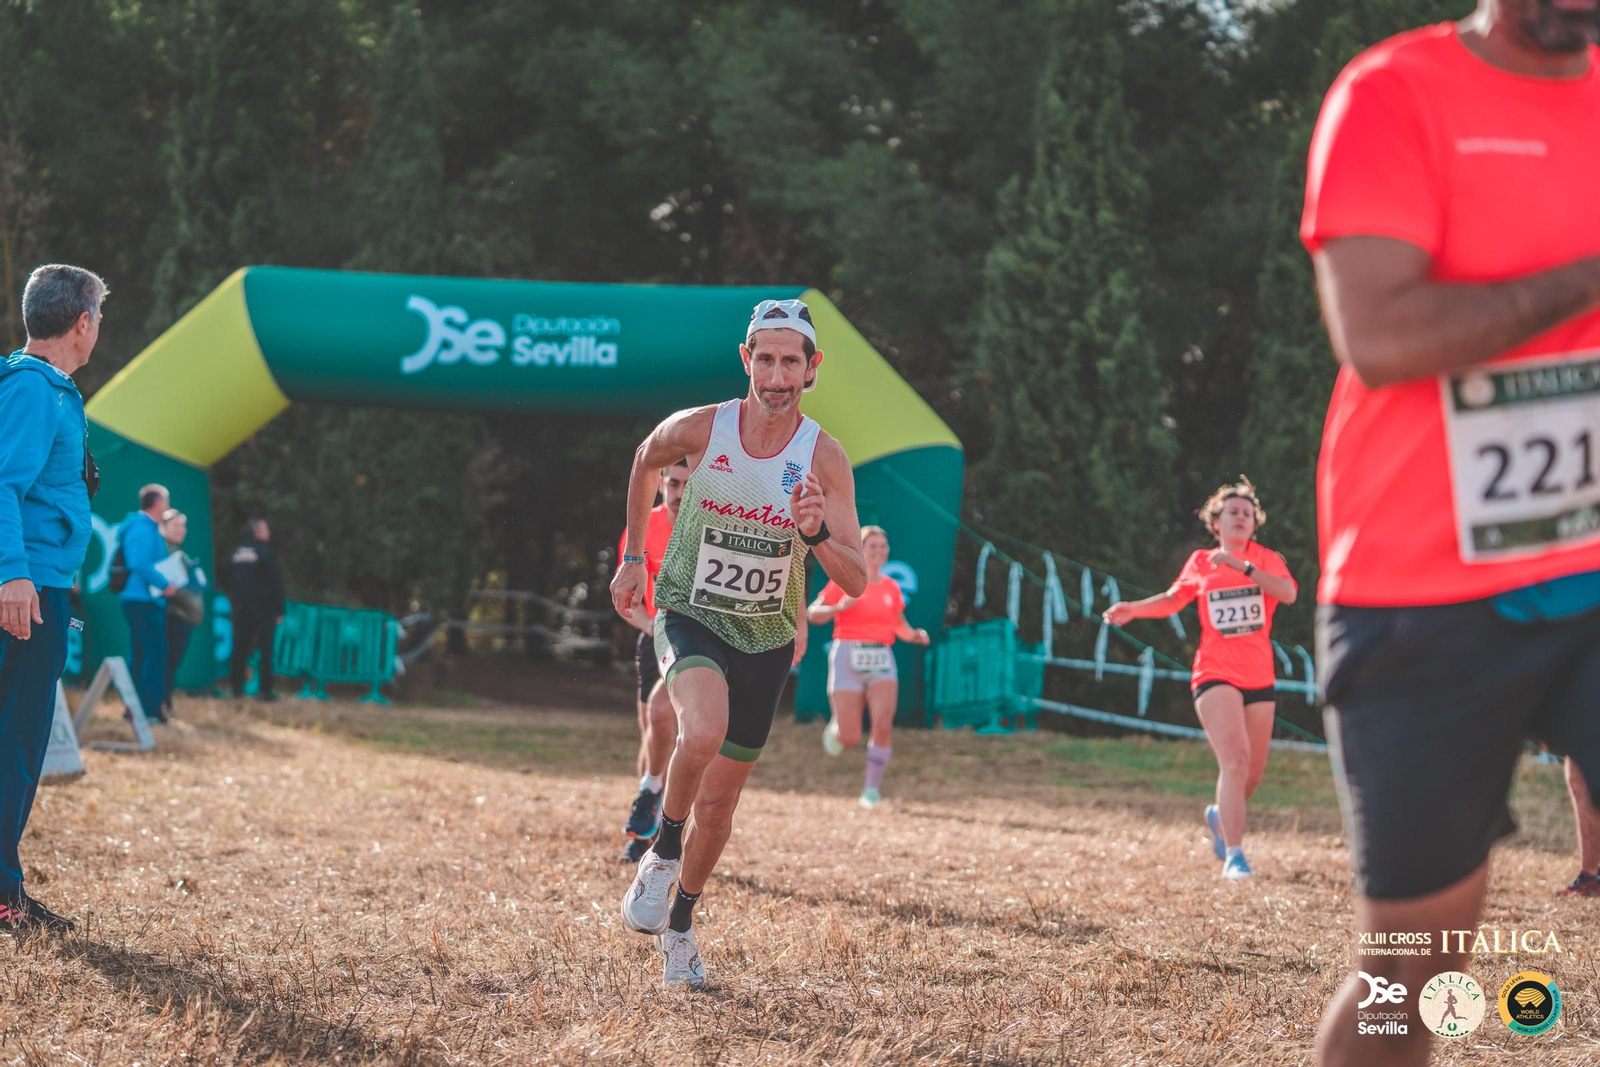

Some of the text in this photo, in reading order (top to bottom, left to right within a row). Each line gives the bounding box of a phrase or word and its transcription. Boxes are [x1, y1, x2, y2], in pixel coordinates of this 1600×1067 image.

[512, 312, 621, 336] Diputación
[511, 335, 619, 367] Sevilla
[700, 498, 797, 530] maratón
[724, 523, 770, 538] JEREZ
[728, 535, 773, 553] ITÁLICA
[704, 558, 784, 595] 2205
[1215, 603, 1261, 624] 2219
